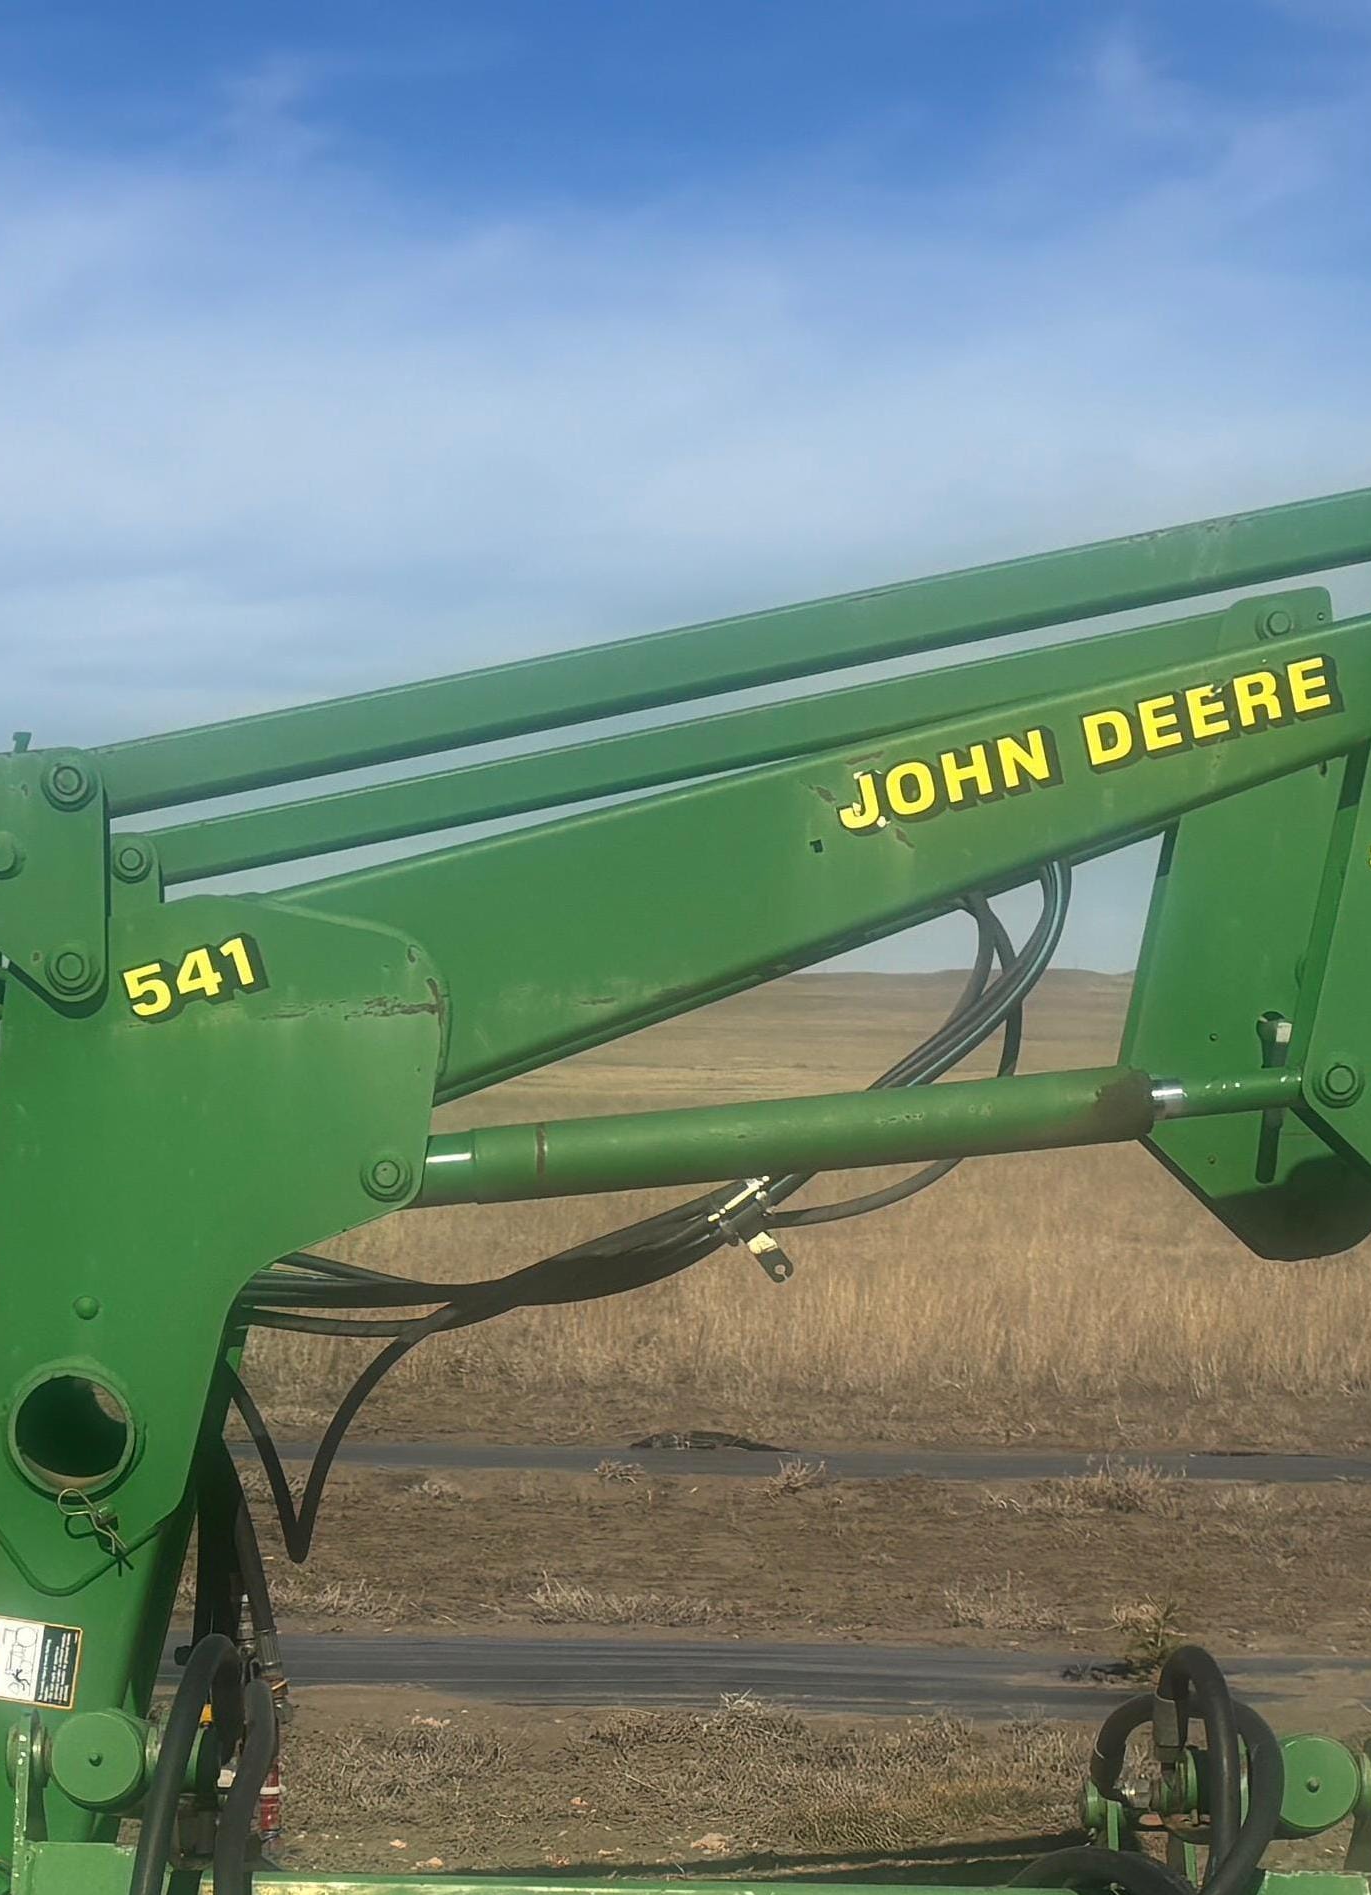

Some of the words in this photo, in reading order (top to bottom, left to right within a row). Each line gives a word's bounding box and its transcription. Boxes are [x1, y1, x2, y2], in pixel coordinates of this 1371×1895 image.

[838, 728, 1051, 831] JOHN
[1081, 656, 1332, 767] DEERE
[123, 937, 256, 1017] 541
